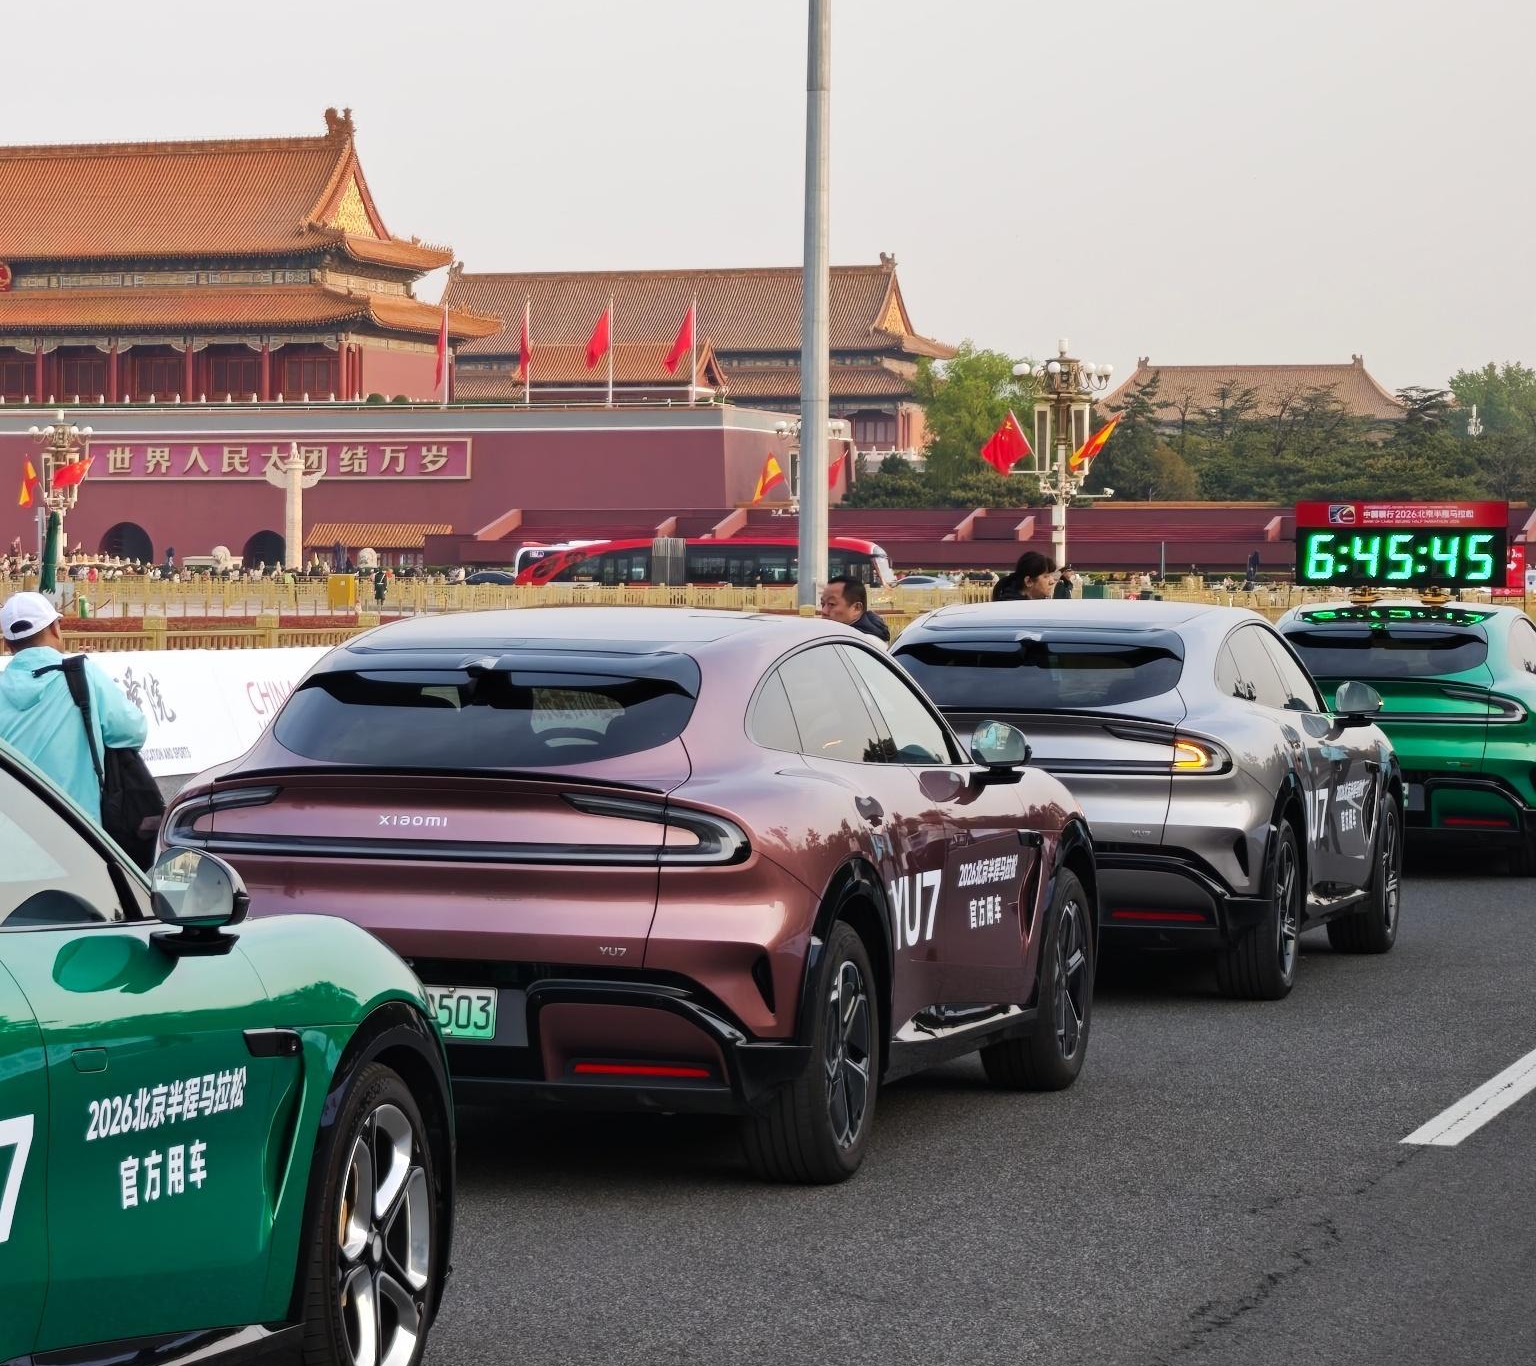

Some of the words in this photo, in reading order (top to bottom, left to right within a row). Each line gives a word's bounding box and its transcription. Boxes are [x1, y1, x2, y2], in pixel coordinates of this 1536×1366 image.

[106, 445, 450, 474] 世界人民大团结万岁
[1306, 534, 1495, 580] 6:45:45
[891, 869, 942, 950] YU7
[969, 894, 1002, 929] 官方用车
[599, 946, 627, 956] YU7
[85, 1065, 249, 1142] 2026北京半程马拉松
[118, 1139, 209, 1211] 官方用车
